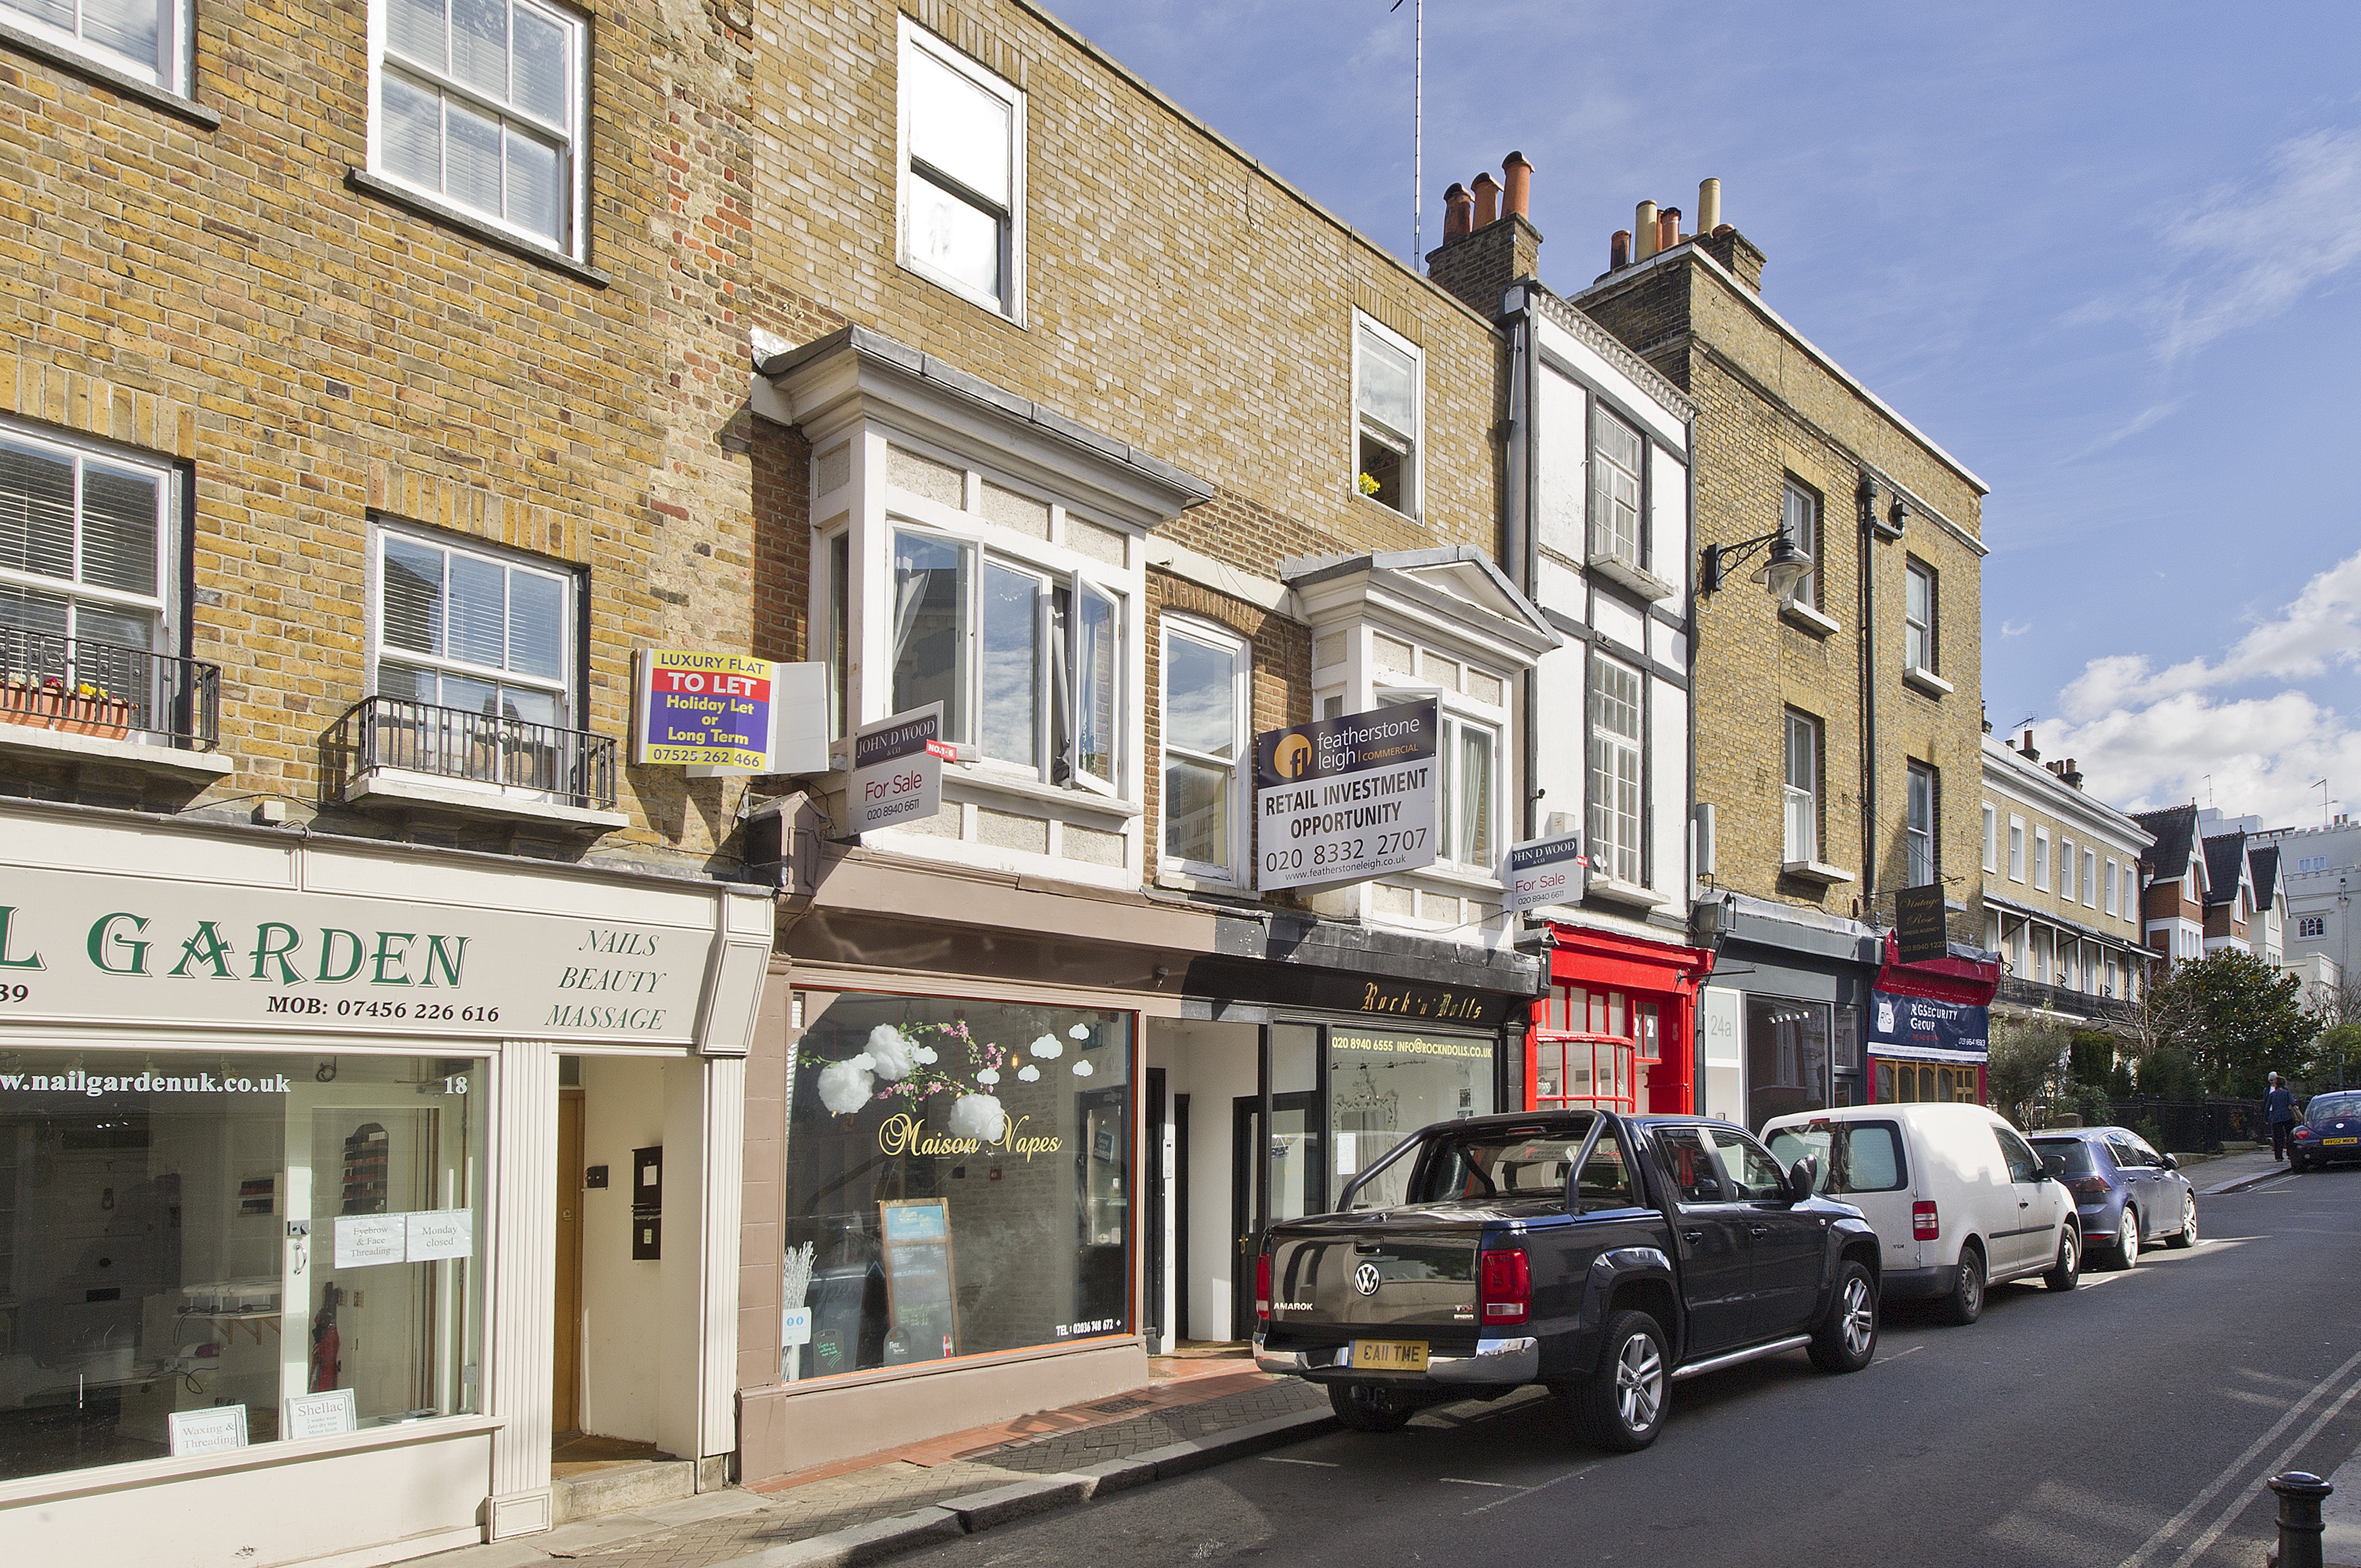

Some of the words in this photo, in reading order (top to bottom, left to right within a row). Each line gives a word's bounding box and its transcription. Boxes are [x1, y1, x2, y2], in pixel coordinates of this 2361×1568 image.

[661, 653, 725, 668] LUXURY
[729, 658, 765, 674] FLAT
[667, 672, 704, 692] TO
[713, 676, 757, 696] LET
[666, 695, 726, 714] Holiday
[730, 699, 754, 715] Let
[701, 716, 718, 725] or
[668, 727, 705, 744] Long
[710, 729, 749, 745] Term
[857, 733, 888, 759] JOHN
[890, 731, 899, 745] D
[901, 720, 935, 742] WOOD
[1317, 718, 1420, 750] featherstone
[654, 749, 698, 761] 07525
[703, 751, 729, 763] 262
[735, 754, 759, 767] 466
[891, 747, 901, 755] CO
[1318, 747, 1356, 771] leigh
[1362, 743, 1418, 761] COMMERCIAL
[865, 781, 889, 802] For
[893, 770, 922, 794] Sale
[1266, 789, 1318, 816] RETAIL
[1324, 767, 1428, 806] INVESTMENT
[867, 808, 882, 820] 020
[883, 802, 904, 816] 8940
[905, 799, 920, 811] 6611
[1291, 801, 1402, 839] OPPORTUNITY
[1266, 848, 1303, 872] 020
[1314, 839, 1364, 865] 8332
[1377, 827, 1427, 855] 2707
[1536, 848, 1543, 858] D
[1545, 841, 1575, 856] WOOD
[1285, 854, 1406, 881] www.featherstoneleigh.co.uk
[1515, 880, 1536, 893] For
[1540, 873, 1565, 888] Sale
[1518, 896, 1531, 905] 020
[1532, 893, 1550, 902] 8940
[1551, 890, 1564, 899] 6611
[1900, 896, 1940, 909] Vintage
[86, 912, 473, 989] GARDEN
[579, 929, 660, 956] NAILS
[557, 966, 667, 993] BEAUTY
[267, 995, 328, 1016] MOB:
[337, 999, 407, 1019] 07456
[414, 1003, 454, 1021] 226
[461, 1005, 499, 1022] 616
[1360, 982, 1411, 1013] Rock
[1435, 992, 1482, 1020] Dolls
[544, 1004, 667, 1030] MASSAGE
[1711, 1015, 1732, 1037] 24a
[1880, 1011, 1891, 1024] RG
[1910, 1017, 1935, 1031] GROUP
[1332, 1036, 1349, 1049] 020
[1350, 1038, 1371, 1050] 8940
[1373, 1039, 1393, 1052] 6555
[1397, 1038, 1492, 1058] INFO@ROCKNDOLLS.CO.UK
[0, 1070, 291, 1097] w.nailgardenuk.co.uk
[444, 1076, 467, 1095] 18
[879, 1113, 981, 1156] Maison
[987, 1113, 1062, 1163] Vapes
[353, 1226, 389, 1237] Eyebrow
[422, 1226, 458, 1237] Monday
[350, 1247, 390, 1257] Threading
[426, 1238, 454, 1247] closed
[1273, 1302, 1313, 1311] AMAROK
[1455, 1305, 1473, 1313] TDI
[1073, 1321, 1091, 1334] 02036
[1091, 1320, 1101, 1332] 748
[1103, 1319, 1113, 1330] 672
[1394, 1345, 1421, 1362] TME
[298, 1402, 343, 1417] Shellac
[183, 1425, 222, 1436] Waxing
[225, 1423, 235, 1431] &
[183, 1435, 236, 1449] Threading
